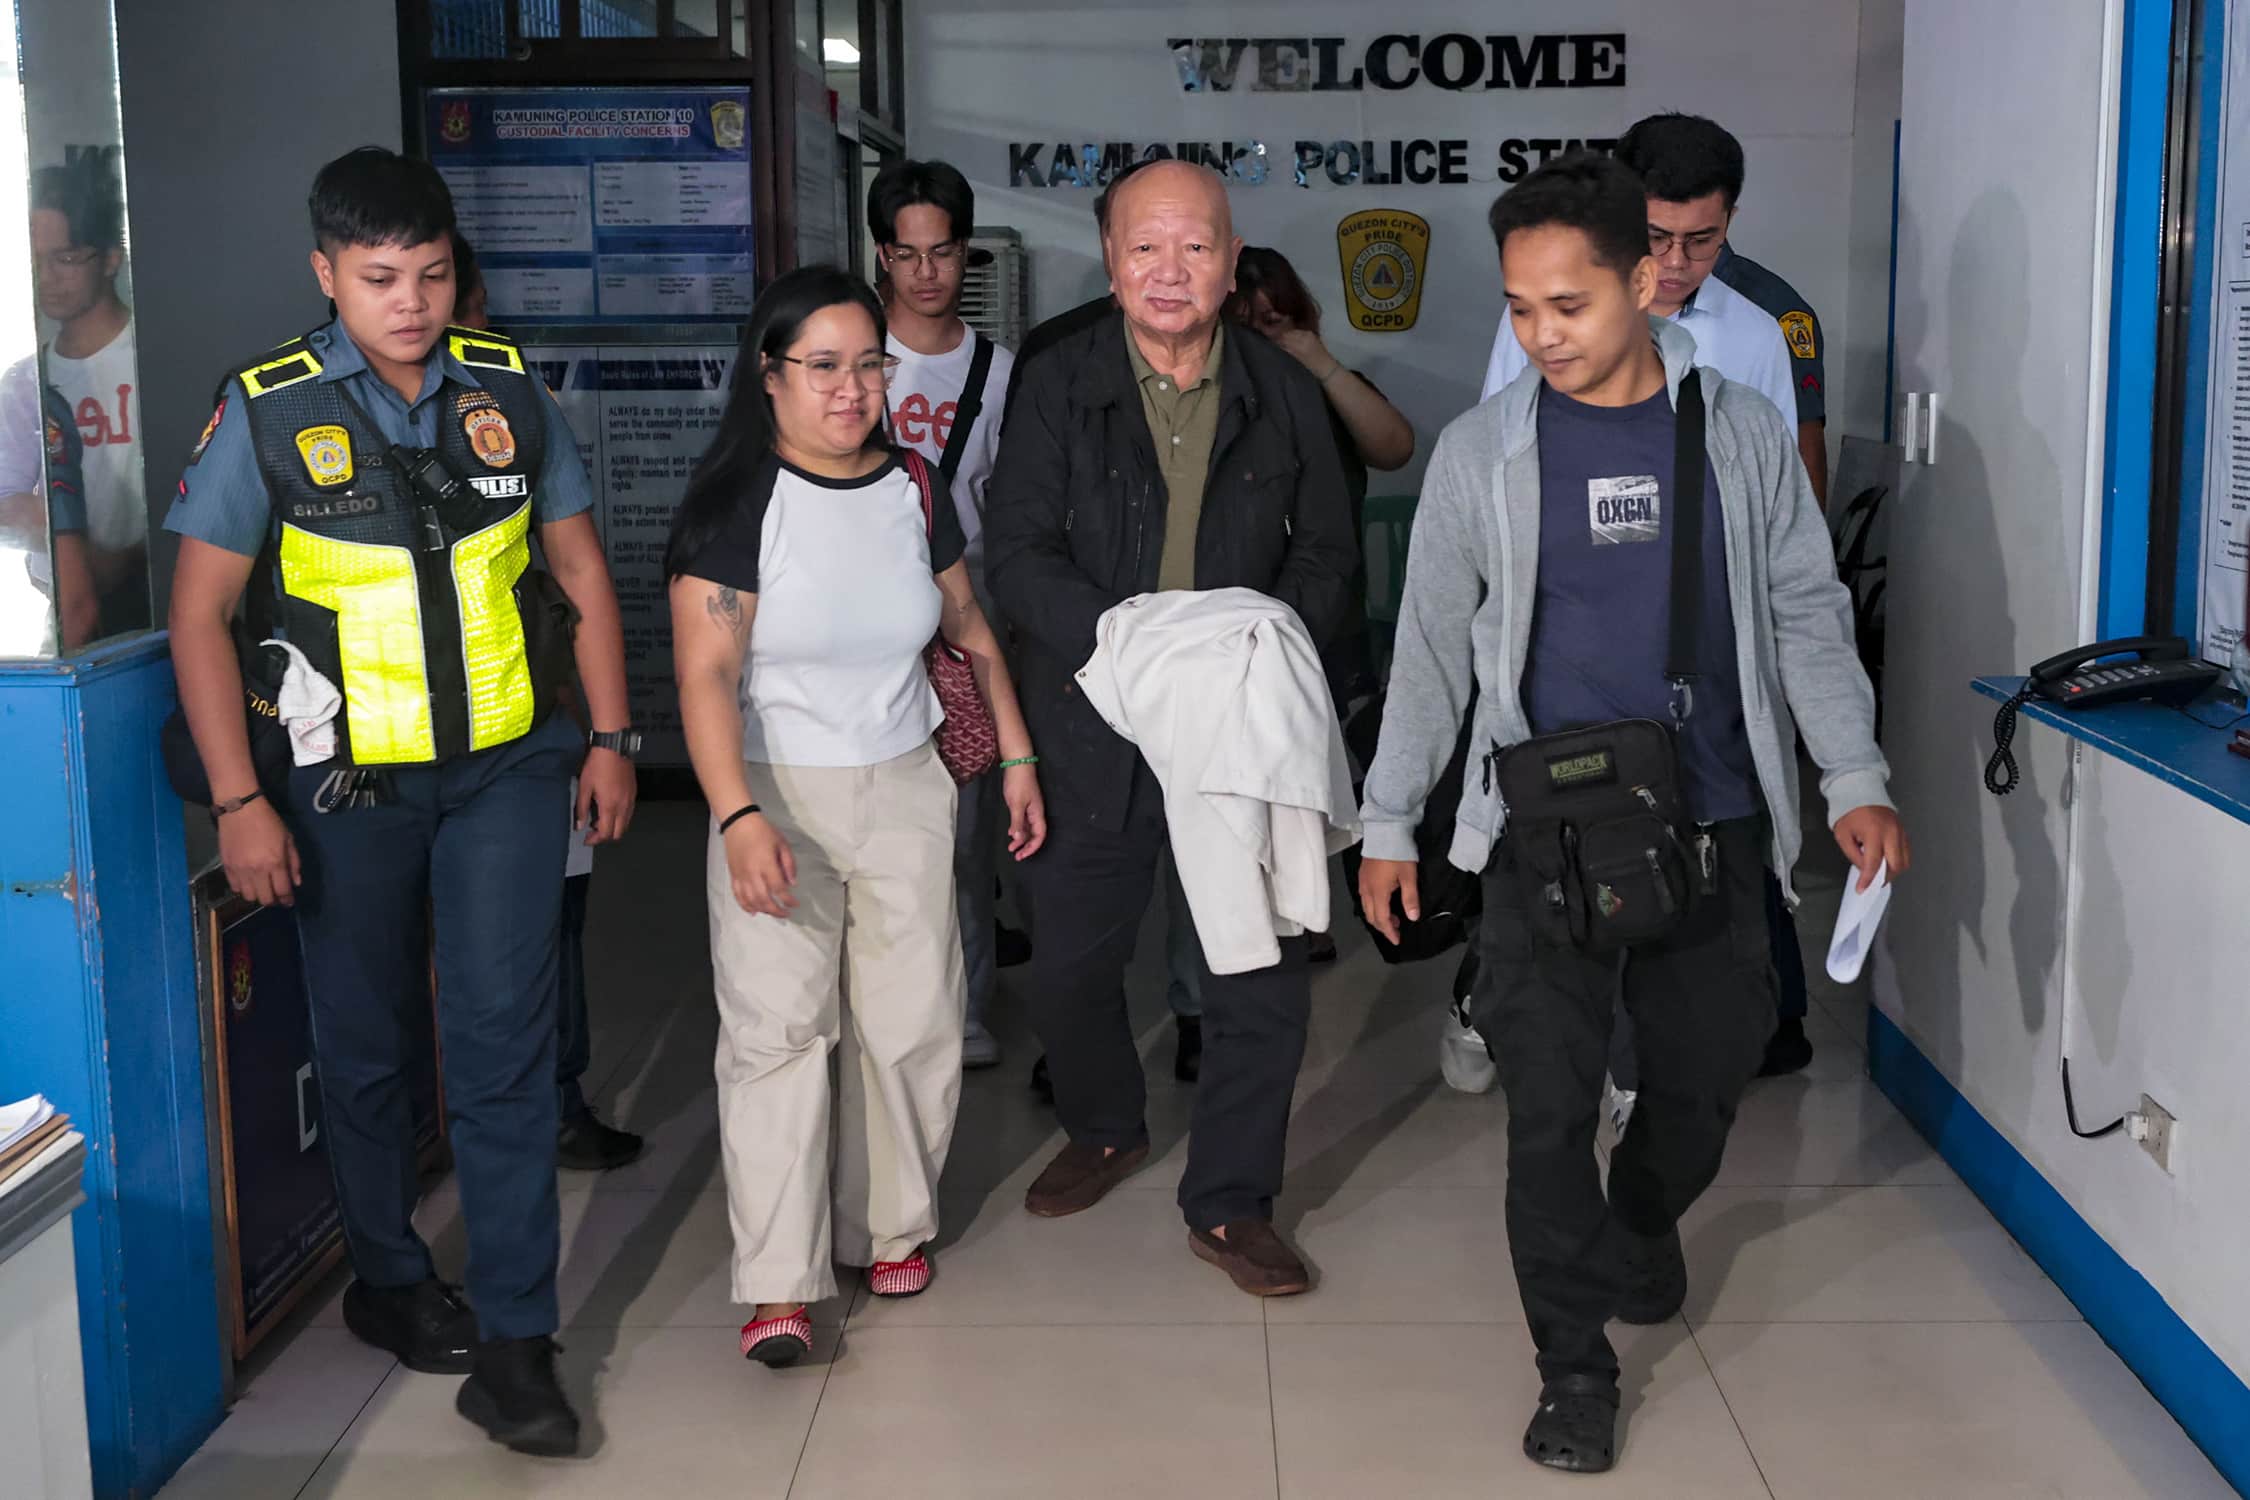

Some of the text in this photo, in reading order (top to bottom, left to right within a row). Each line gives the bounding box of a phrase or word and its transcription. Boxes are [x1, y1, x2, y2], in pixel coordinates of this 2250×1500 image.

[1167, 33, 1626, 92] WELCOME
[494, 108, 694, 123] KAMUNING POLICE STATION 10
[496, 125, 691, 138] CUSTODIAL FACILITY CONCERNS
[1294, 139, 1468, 187] POLICE
[1498, 139, 1619, 183] STT
[1341, 218, 1388, 236] QUEZON
[1364, 230, 1403, 242] PRIDE
[1361, 314, 1404, 327] QCPD
[608, 406, 638, 416] ALWAYS
[321, 474, 348, 484] QCPD
[471, 479, 520, 495] ULIS
[294, 497, 377, 516] SILLEDO
[1597, 498, 1651, 524] OXGN
[247, 689, 279, 718] PUL
